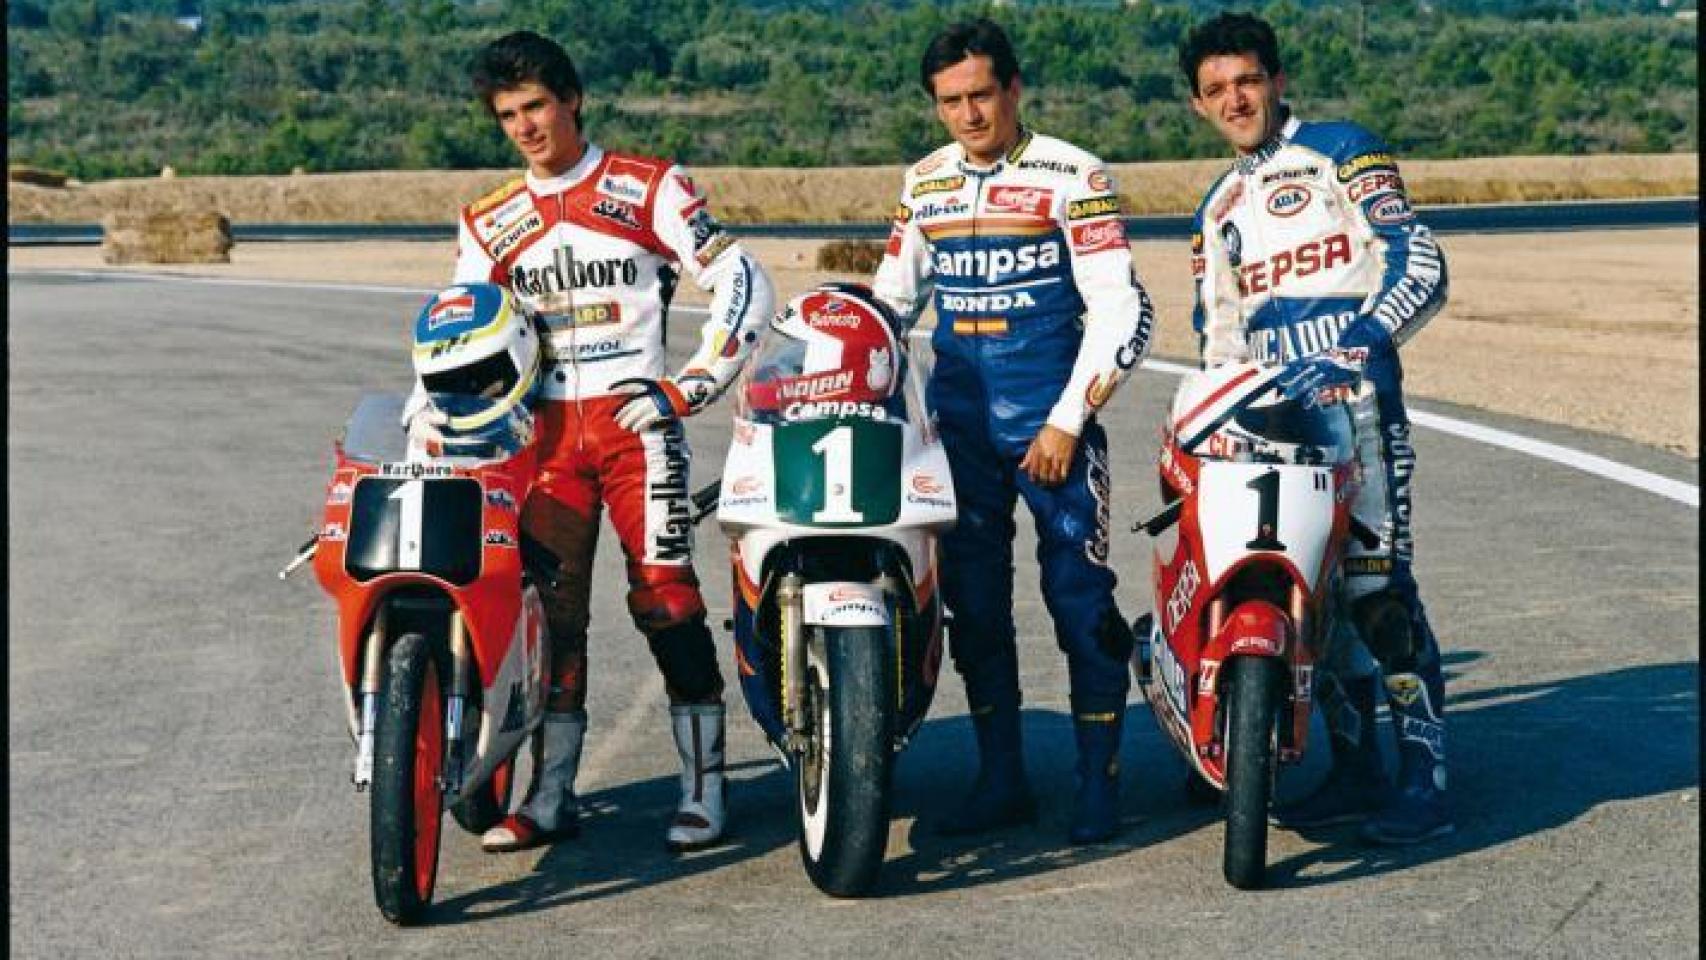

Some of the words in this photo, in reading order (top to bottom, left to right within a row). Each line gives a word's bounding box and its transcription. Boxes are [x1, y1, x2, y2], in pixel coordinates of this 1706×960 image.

[1018, 159, 1078, 175] MICHELIN
[511, 243, 638, 297] Marlboro
[785, 401, 886, 421] Campsa
[382, 463, 452, 478] Marlboro
[812, 426, 864, 523] 1
[387, 479, 424, 570] 1
[1245, 470, 1288, 551] 1
